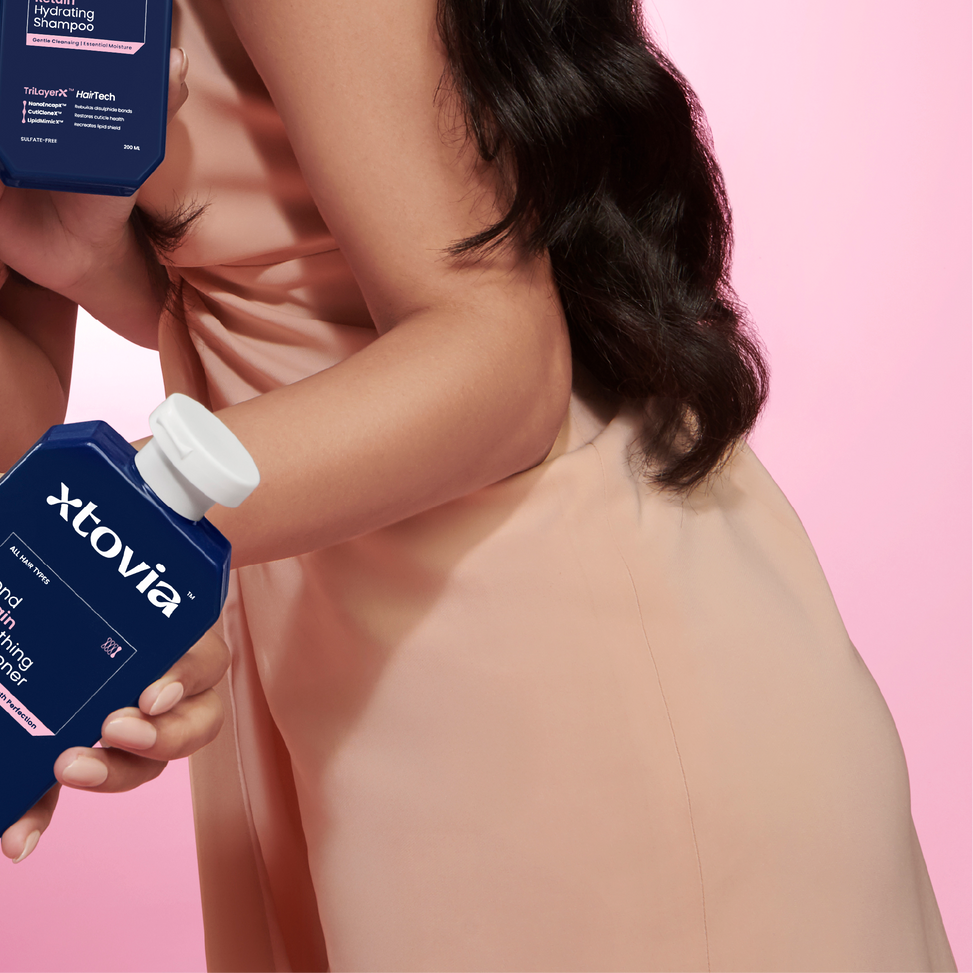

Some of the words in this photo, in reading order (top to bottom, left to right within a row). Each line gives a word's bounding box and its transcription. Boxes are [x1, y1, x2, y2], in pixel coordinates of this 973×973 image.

[34, 4, 95, 22] Hydrating
[33, 17, 95, 33] Shampoo
[51, 38, 79, 47] Cleansing
[76, 90, 116, 101] HairTech
[9, 546, 21, 557] ALL
[19, 554, 34, 570] HAIR
[33, 567, 51, 585] TYPES
[6, 698, 37, 730] Perfection
